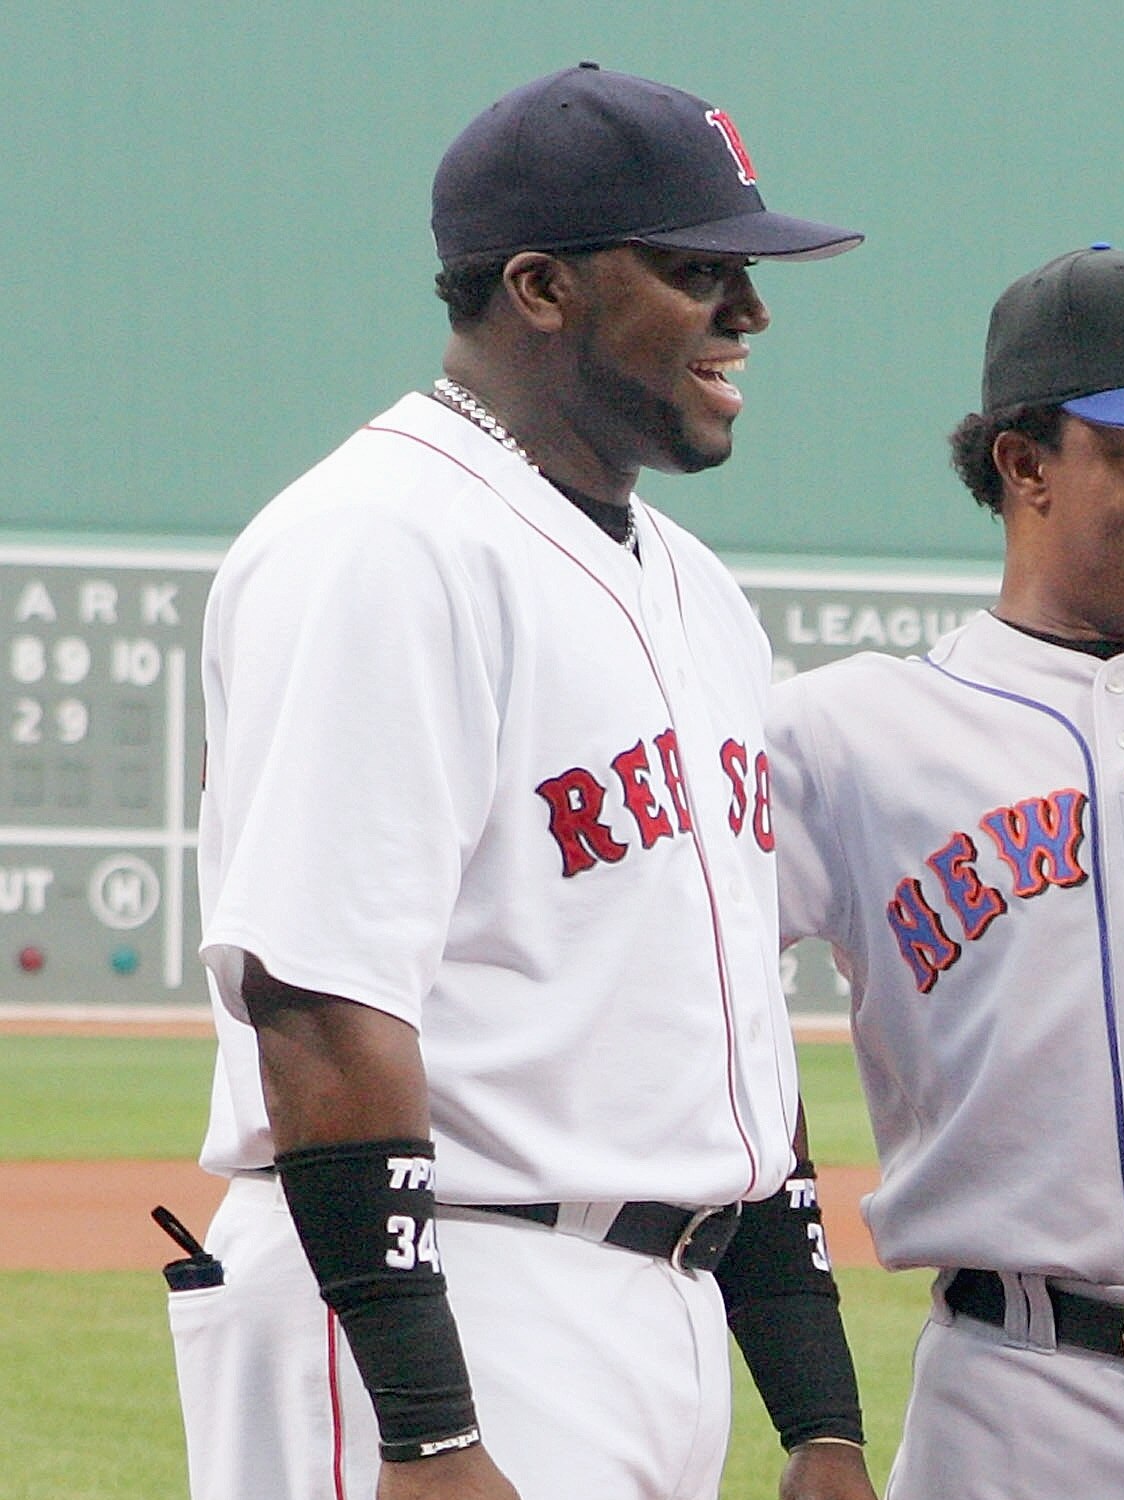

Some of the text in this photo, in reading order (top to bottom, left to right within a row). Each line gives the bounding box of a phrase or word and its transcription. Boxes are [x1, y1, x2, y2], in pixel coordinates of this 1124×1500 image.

[786, 603, 982, 648] LEAGU
[886, 788, 1090, 994] NEW
[385, 1215, 440, 1273] 34
